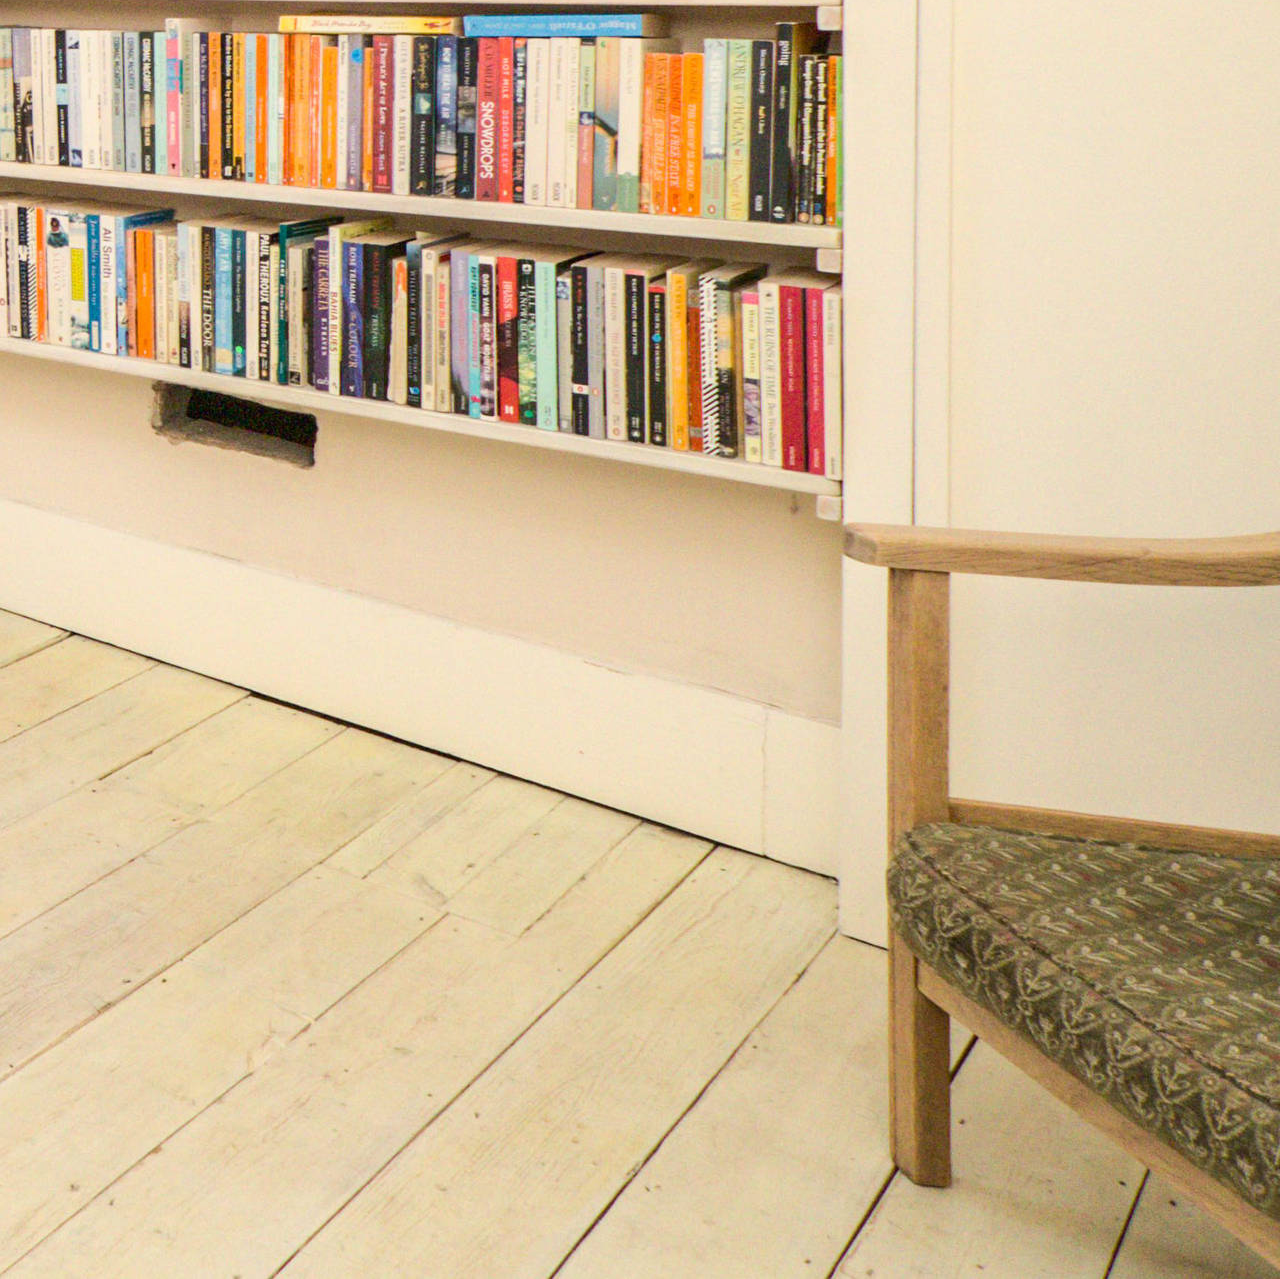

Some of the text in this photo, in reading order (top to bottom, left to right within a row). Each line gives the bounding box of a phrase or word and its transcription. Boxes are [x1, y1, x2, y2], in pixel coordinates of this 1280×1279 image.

[142, 38, 152, 92] CORMAC McCARTHY
[378, 47, 387, 80] PEOPLE'S
[441, 47, 452, 65] HOW
[733, 41, 748, 92] ANDREW
[112, 60, 122, 90] McCARTHY
[127, 60, 136, 91] McCARTHY
[378, 81, 387, 96] ACT
[379, 106, 387, 125] LOVE
[440, 107, 452, 119] AIR
[501, 57, 510, 175] HOT MILK DEBORAH LEVY
[479, 101, 495, 180] SNOWDROPS
[669, 135, 680, 159] FREE
[669, 160, 680, 187] STATE
[102, 227, 113, 242] Ali
[218, 230, 231, 273] AMY TAN
[260, 234, 270, 257] PAUL
[102, 245, 113, 279] Smith
[260, 260, 269, 303] THEROUX
[202, 288, 213, 347] THE DOOR
[329, 291, 339, 353] BAHIA BLUES
[347, 246, 359, 369] ROSE TREMAIN COLOUR
[482, 273, 492, 382] DAVID VANN GOAT MOUNTAIN
[763, 306, 776, 399] THE RUINS OF TIME
